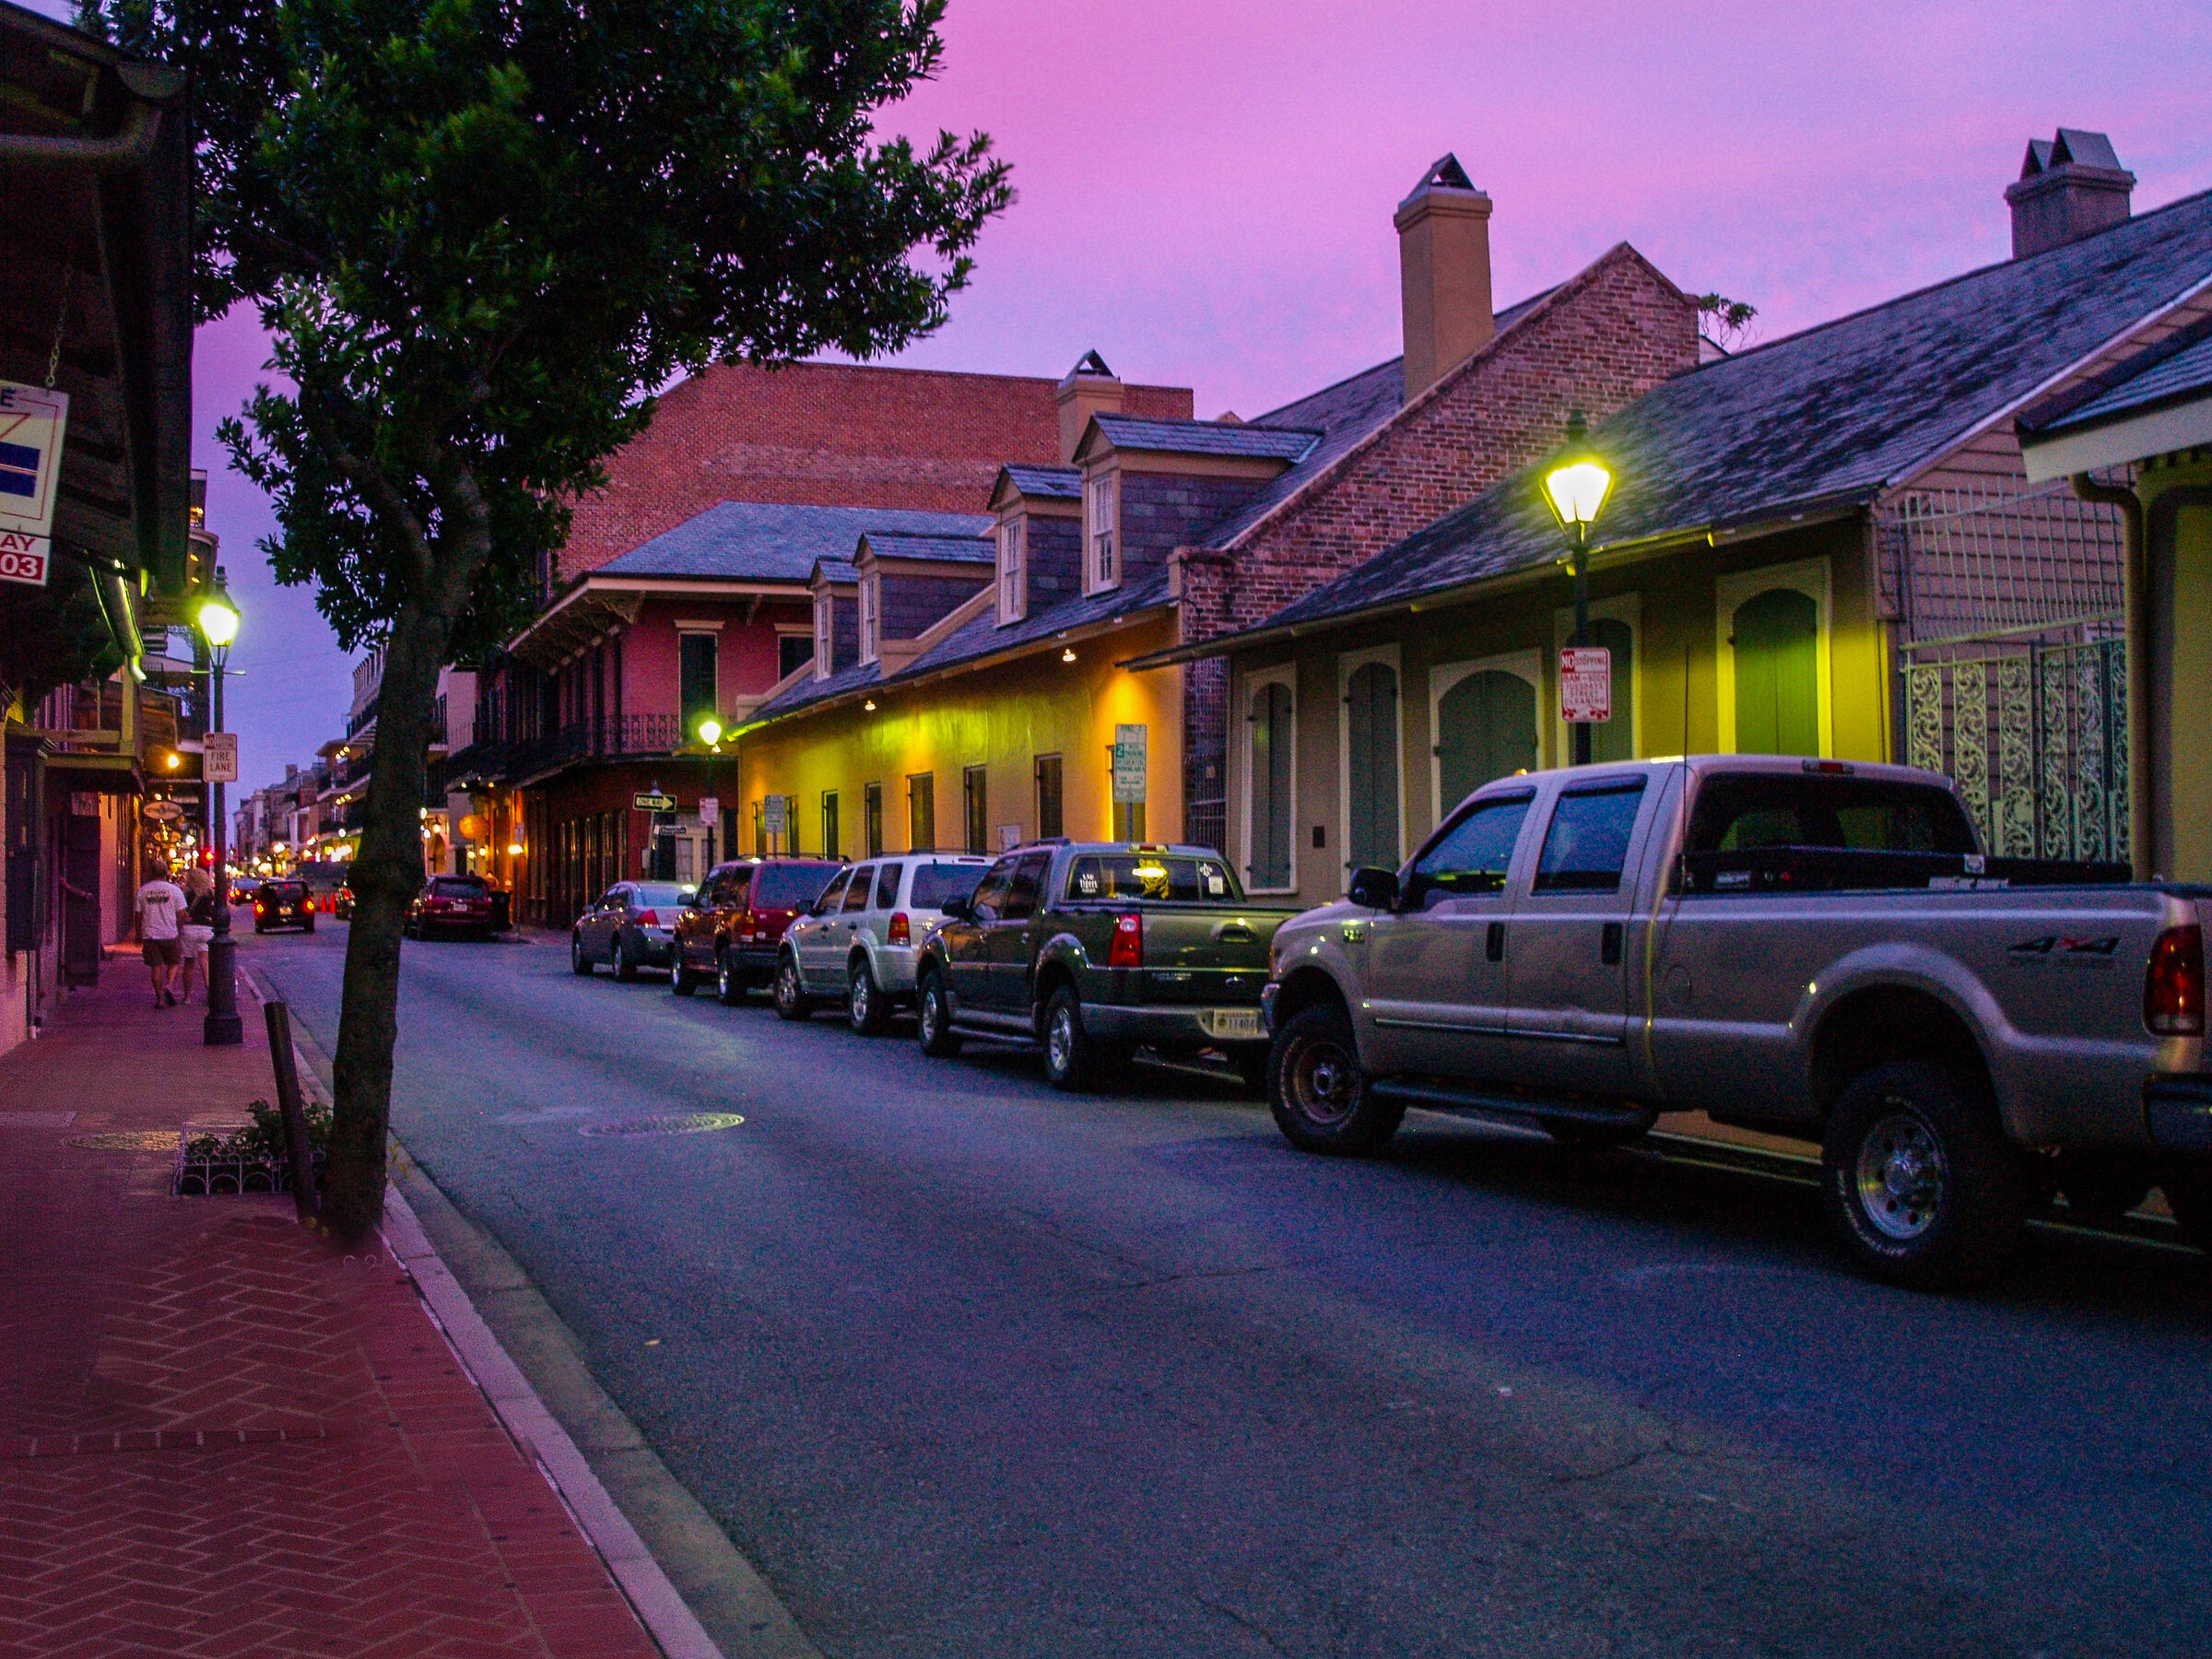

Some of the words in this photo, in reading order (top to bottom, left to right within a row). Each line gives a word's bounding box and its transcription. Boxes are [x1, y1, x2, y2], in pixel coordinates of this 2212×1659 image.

[1561, 654, 1574, 668] NO
[1575, 656, 1606, 665] STOPPING
[211, 752, 230, 761] FIRE
[209, 762, 232, 772] LANE
[638, 797, 650, 806] ONE
[651, 798, 663, 807] WAY
